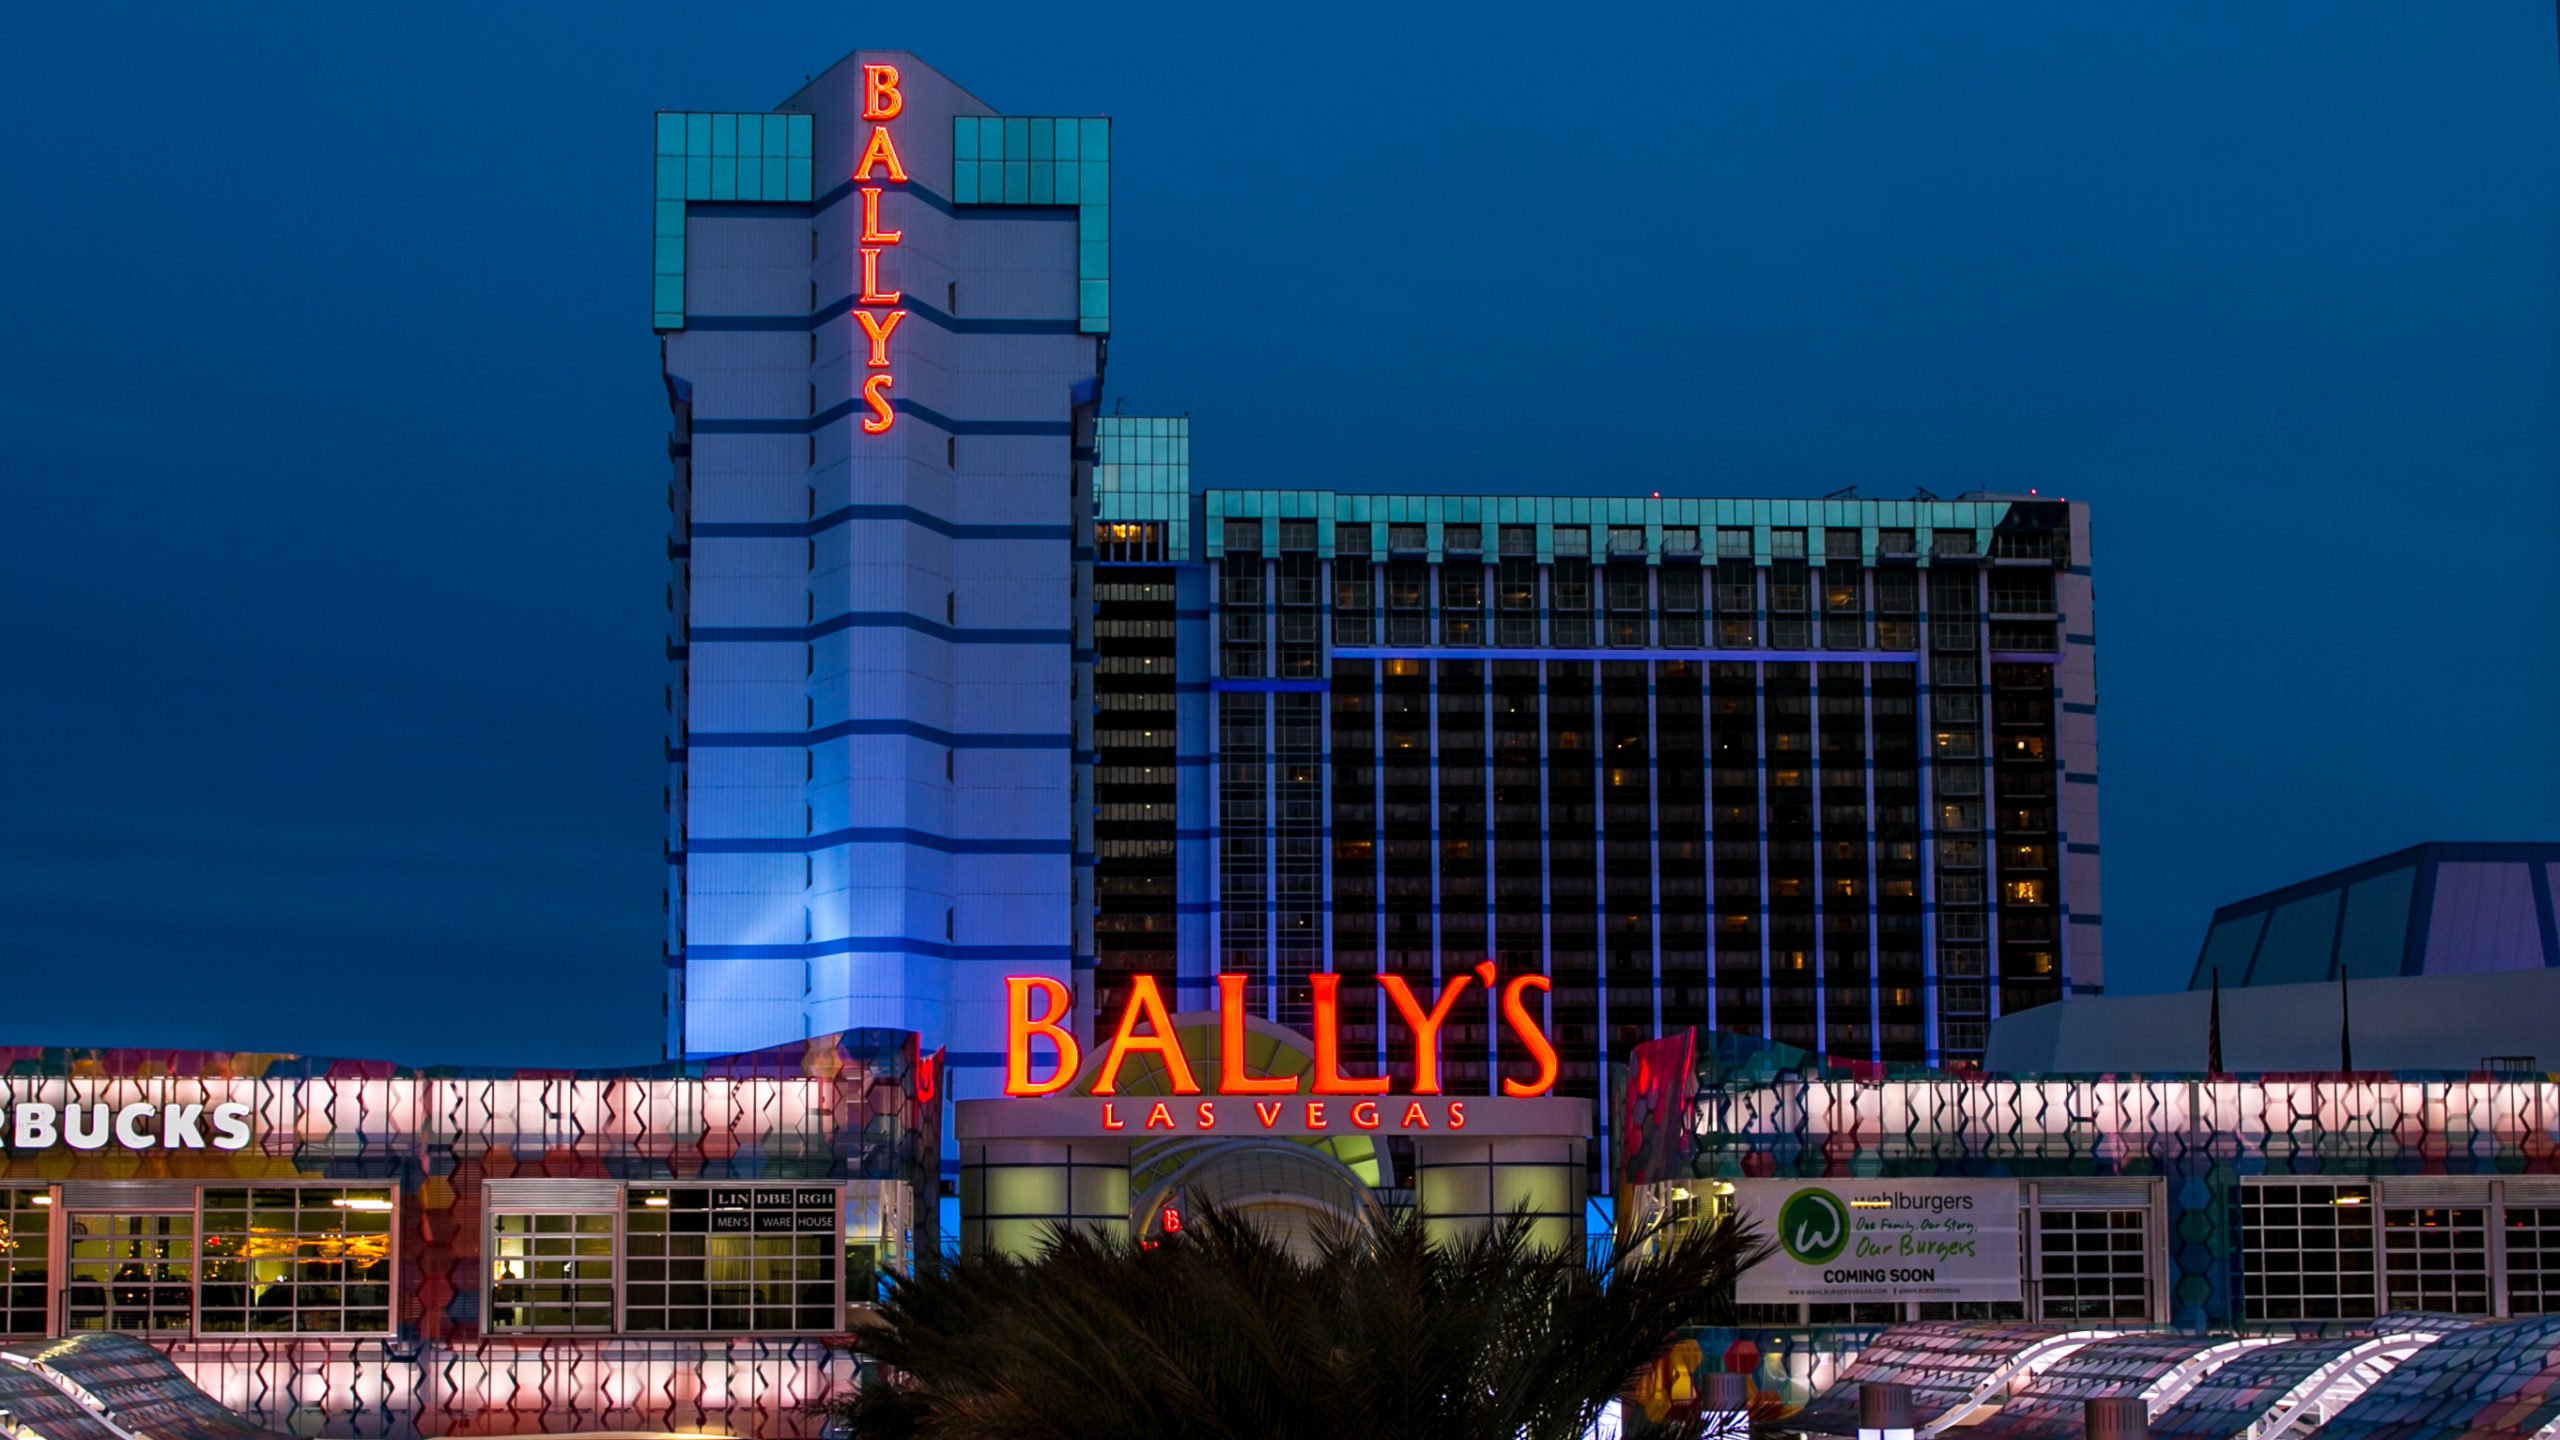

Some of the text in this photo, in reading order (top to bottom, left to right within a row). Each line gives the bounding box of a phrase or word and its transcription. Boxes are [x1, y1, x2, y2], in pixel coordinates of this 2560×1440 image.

[853, 64, 908, 434] BALLYS
[1004, 960, 1557, 1098] BALLY'S
[0, 1102, 251, 1150] BUCKS
[1102, 1102, 1466, 1130] LAS VEGAS
[717, 1216, 749, 1227] MEN'S
[1855, 1234, 1976, 1262] Our Burgers
[1824, 1268, 1935, 1283] COMING SOON
